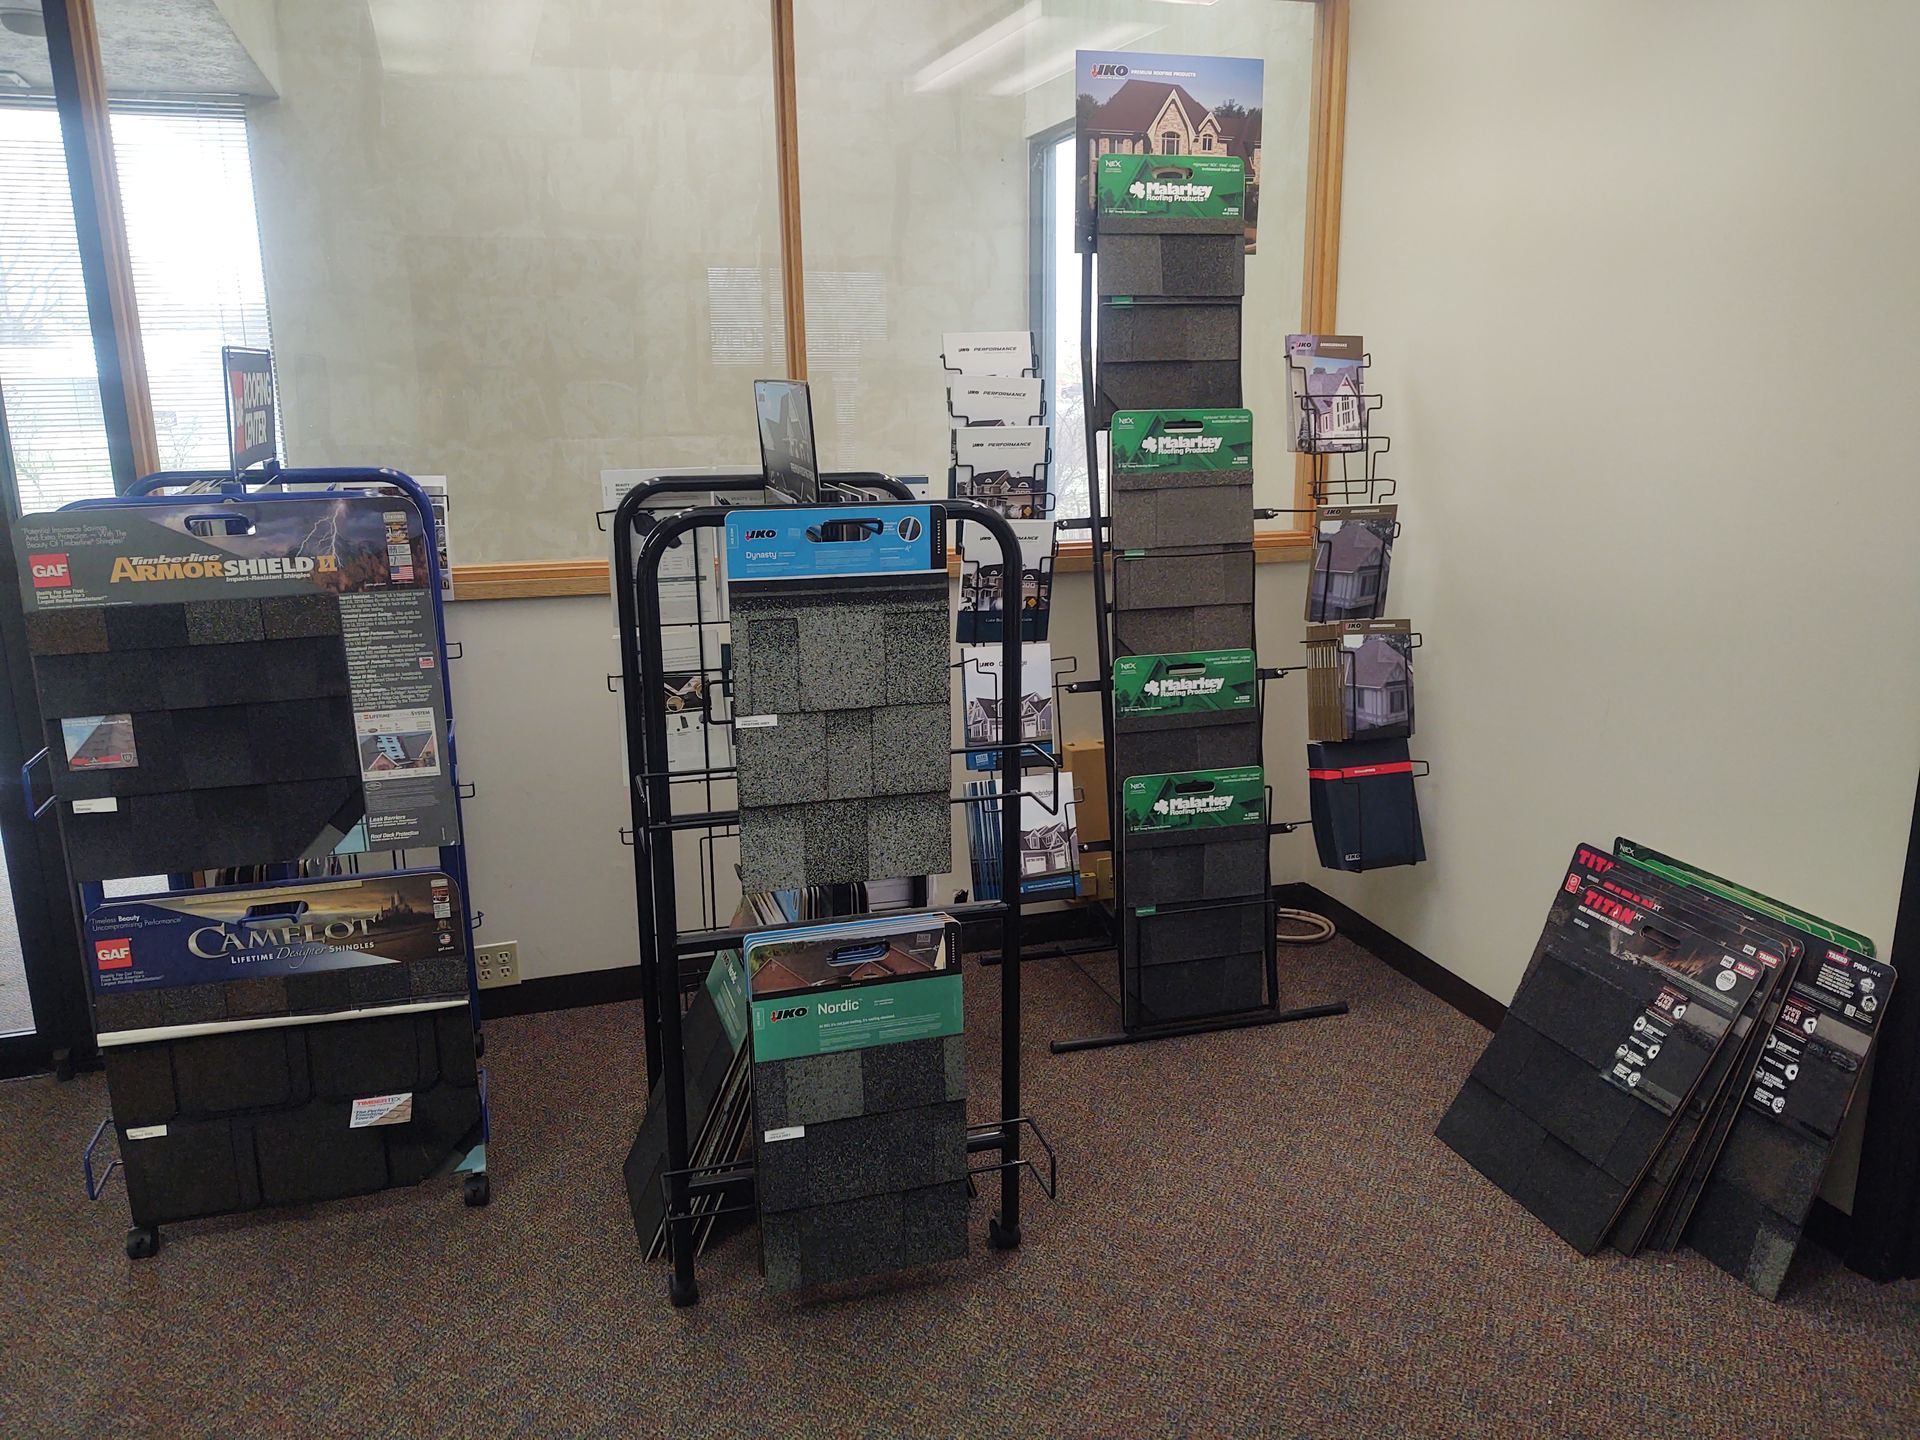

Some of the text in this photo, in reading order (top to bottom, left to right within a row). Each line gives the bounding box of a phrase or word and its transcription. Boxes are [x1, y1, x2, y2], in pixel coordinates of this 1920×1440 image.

[1094, 63, 1129, 78] IKO
[1146, 182, 1214, 198] Malarkey
[243, 371, 272, 410] ROOFING
[244, 410, 268, 450] CENTER
[1158, 436, 1223, 450] Malarkey
[1158, 447, 1184, 456] Roofing
[748, 530, 777, 540] IKO
[129, 553, 221, 566] Timberline
[746, 551, 777, 560] Dynasty
[32, 564, 68, 578] GAF
[110, 556, 314, 583] ARMORSHIELD
[226, 573, 311, 583] Impact-Resistant Shingles
[1160, 677, 1224, 691] Malarkey
[1170, 795, 1234, 810] Malarkey
[1620, 843, 1635, 856] NEX
[1584, 890, 1636, 925] TITAN
[1634, 912, 1644, 922] XT
[92, 922, 143, 932] Uncompromising
[187, 917, 376, 959] CAMELOT
[98, 948, 130, 960] GAF
[231, 941, 375, 969] LIFETIME Designer SHINGLES
[1759, 952, 1776, 964] TAMKO
[1828, 952, 1848, 964] TAMKO
[1738, 963, 1756, 976] TAMKO
[818, 999, 860, 1015] Nordic
[1785, 1005, 1801, 1014] RAPID
[773, 1007, 808, 1022] IKO
[1781, 1014, 1797, 1024] ZONE
[1783, 1009, 1800, 1020] FIRE
[1763, 1056, 1785, 1070] POWER CORE
[358, 1097, 401, 1106] TIMBERTEX
